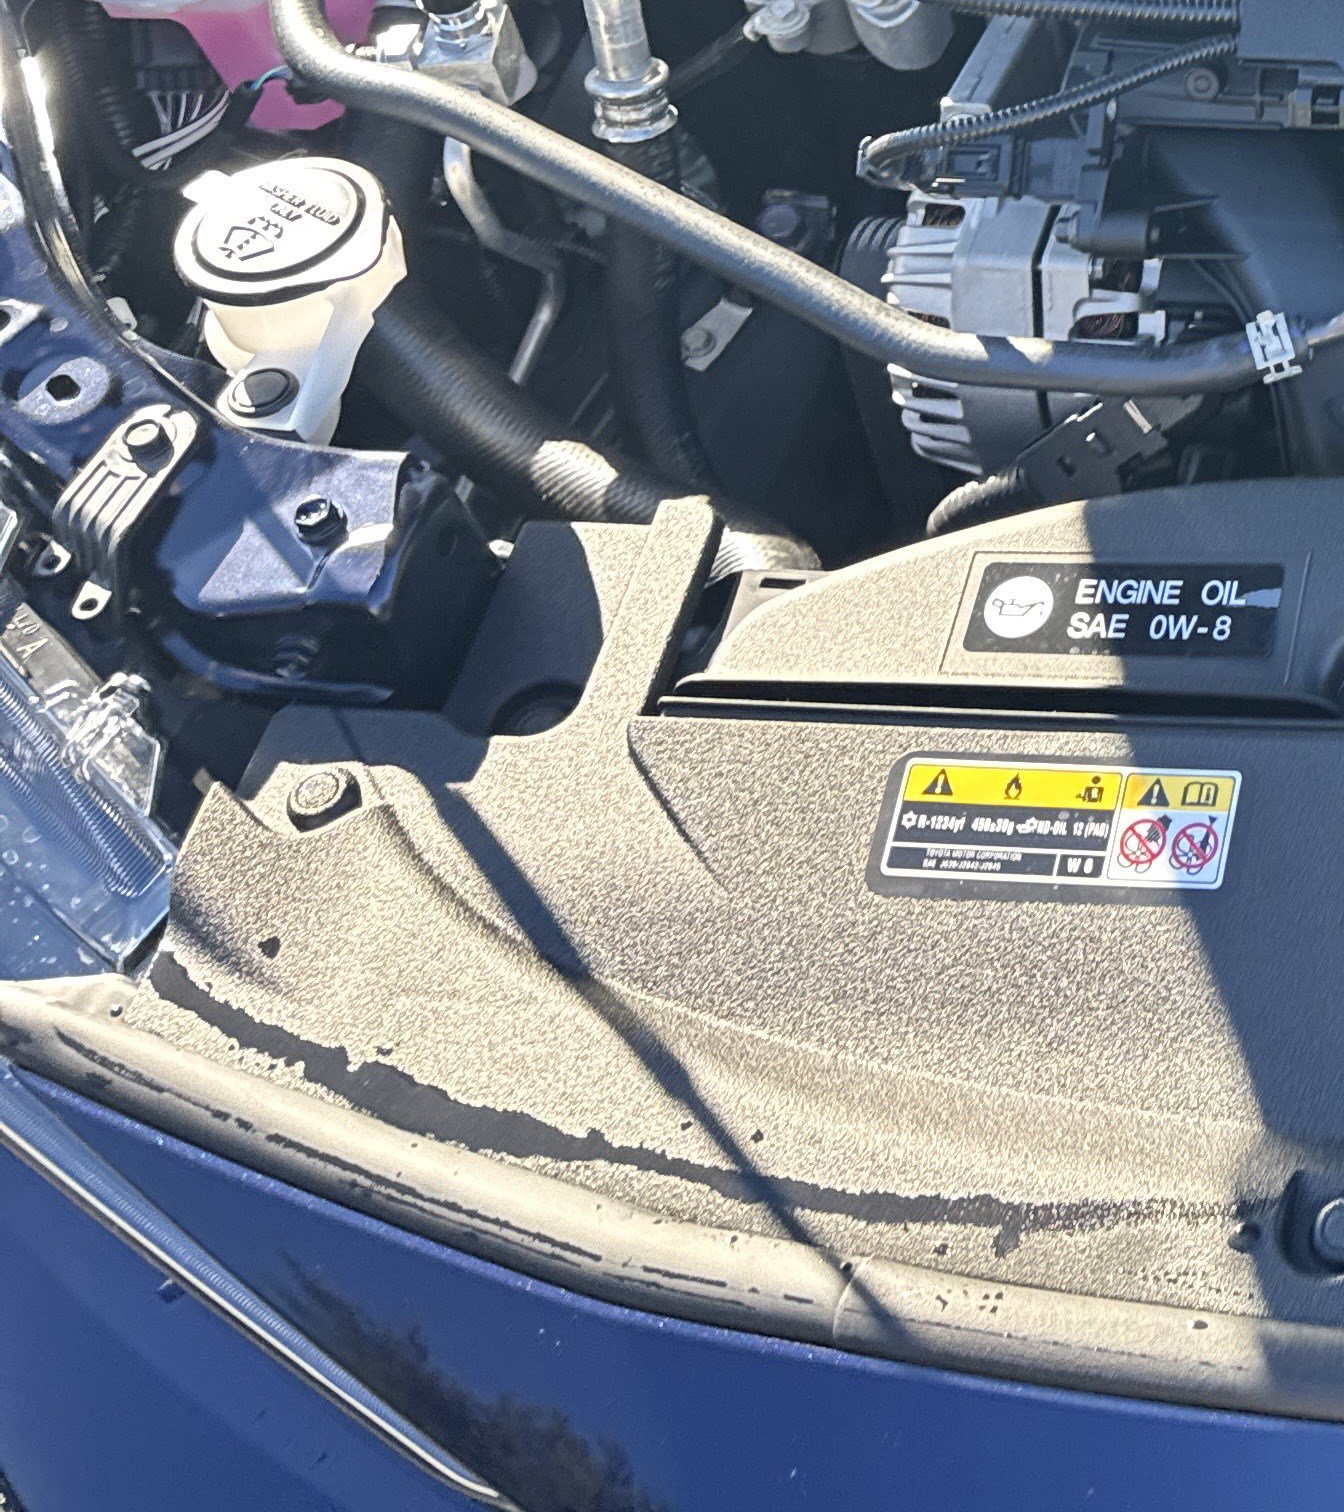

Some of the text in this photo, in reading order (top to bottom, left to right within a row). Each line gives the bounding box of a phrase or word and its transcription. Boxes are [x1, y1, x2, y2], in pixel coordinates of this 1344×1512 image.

[1075, 578, 1246, 606] ENGINE OIL
[1066, 612, 1232, 641] SAE 0W-8
[926, 848, 951, 858] TOYOTA
